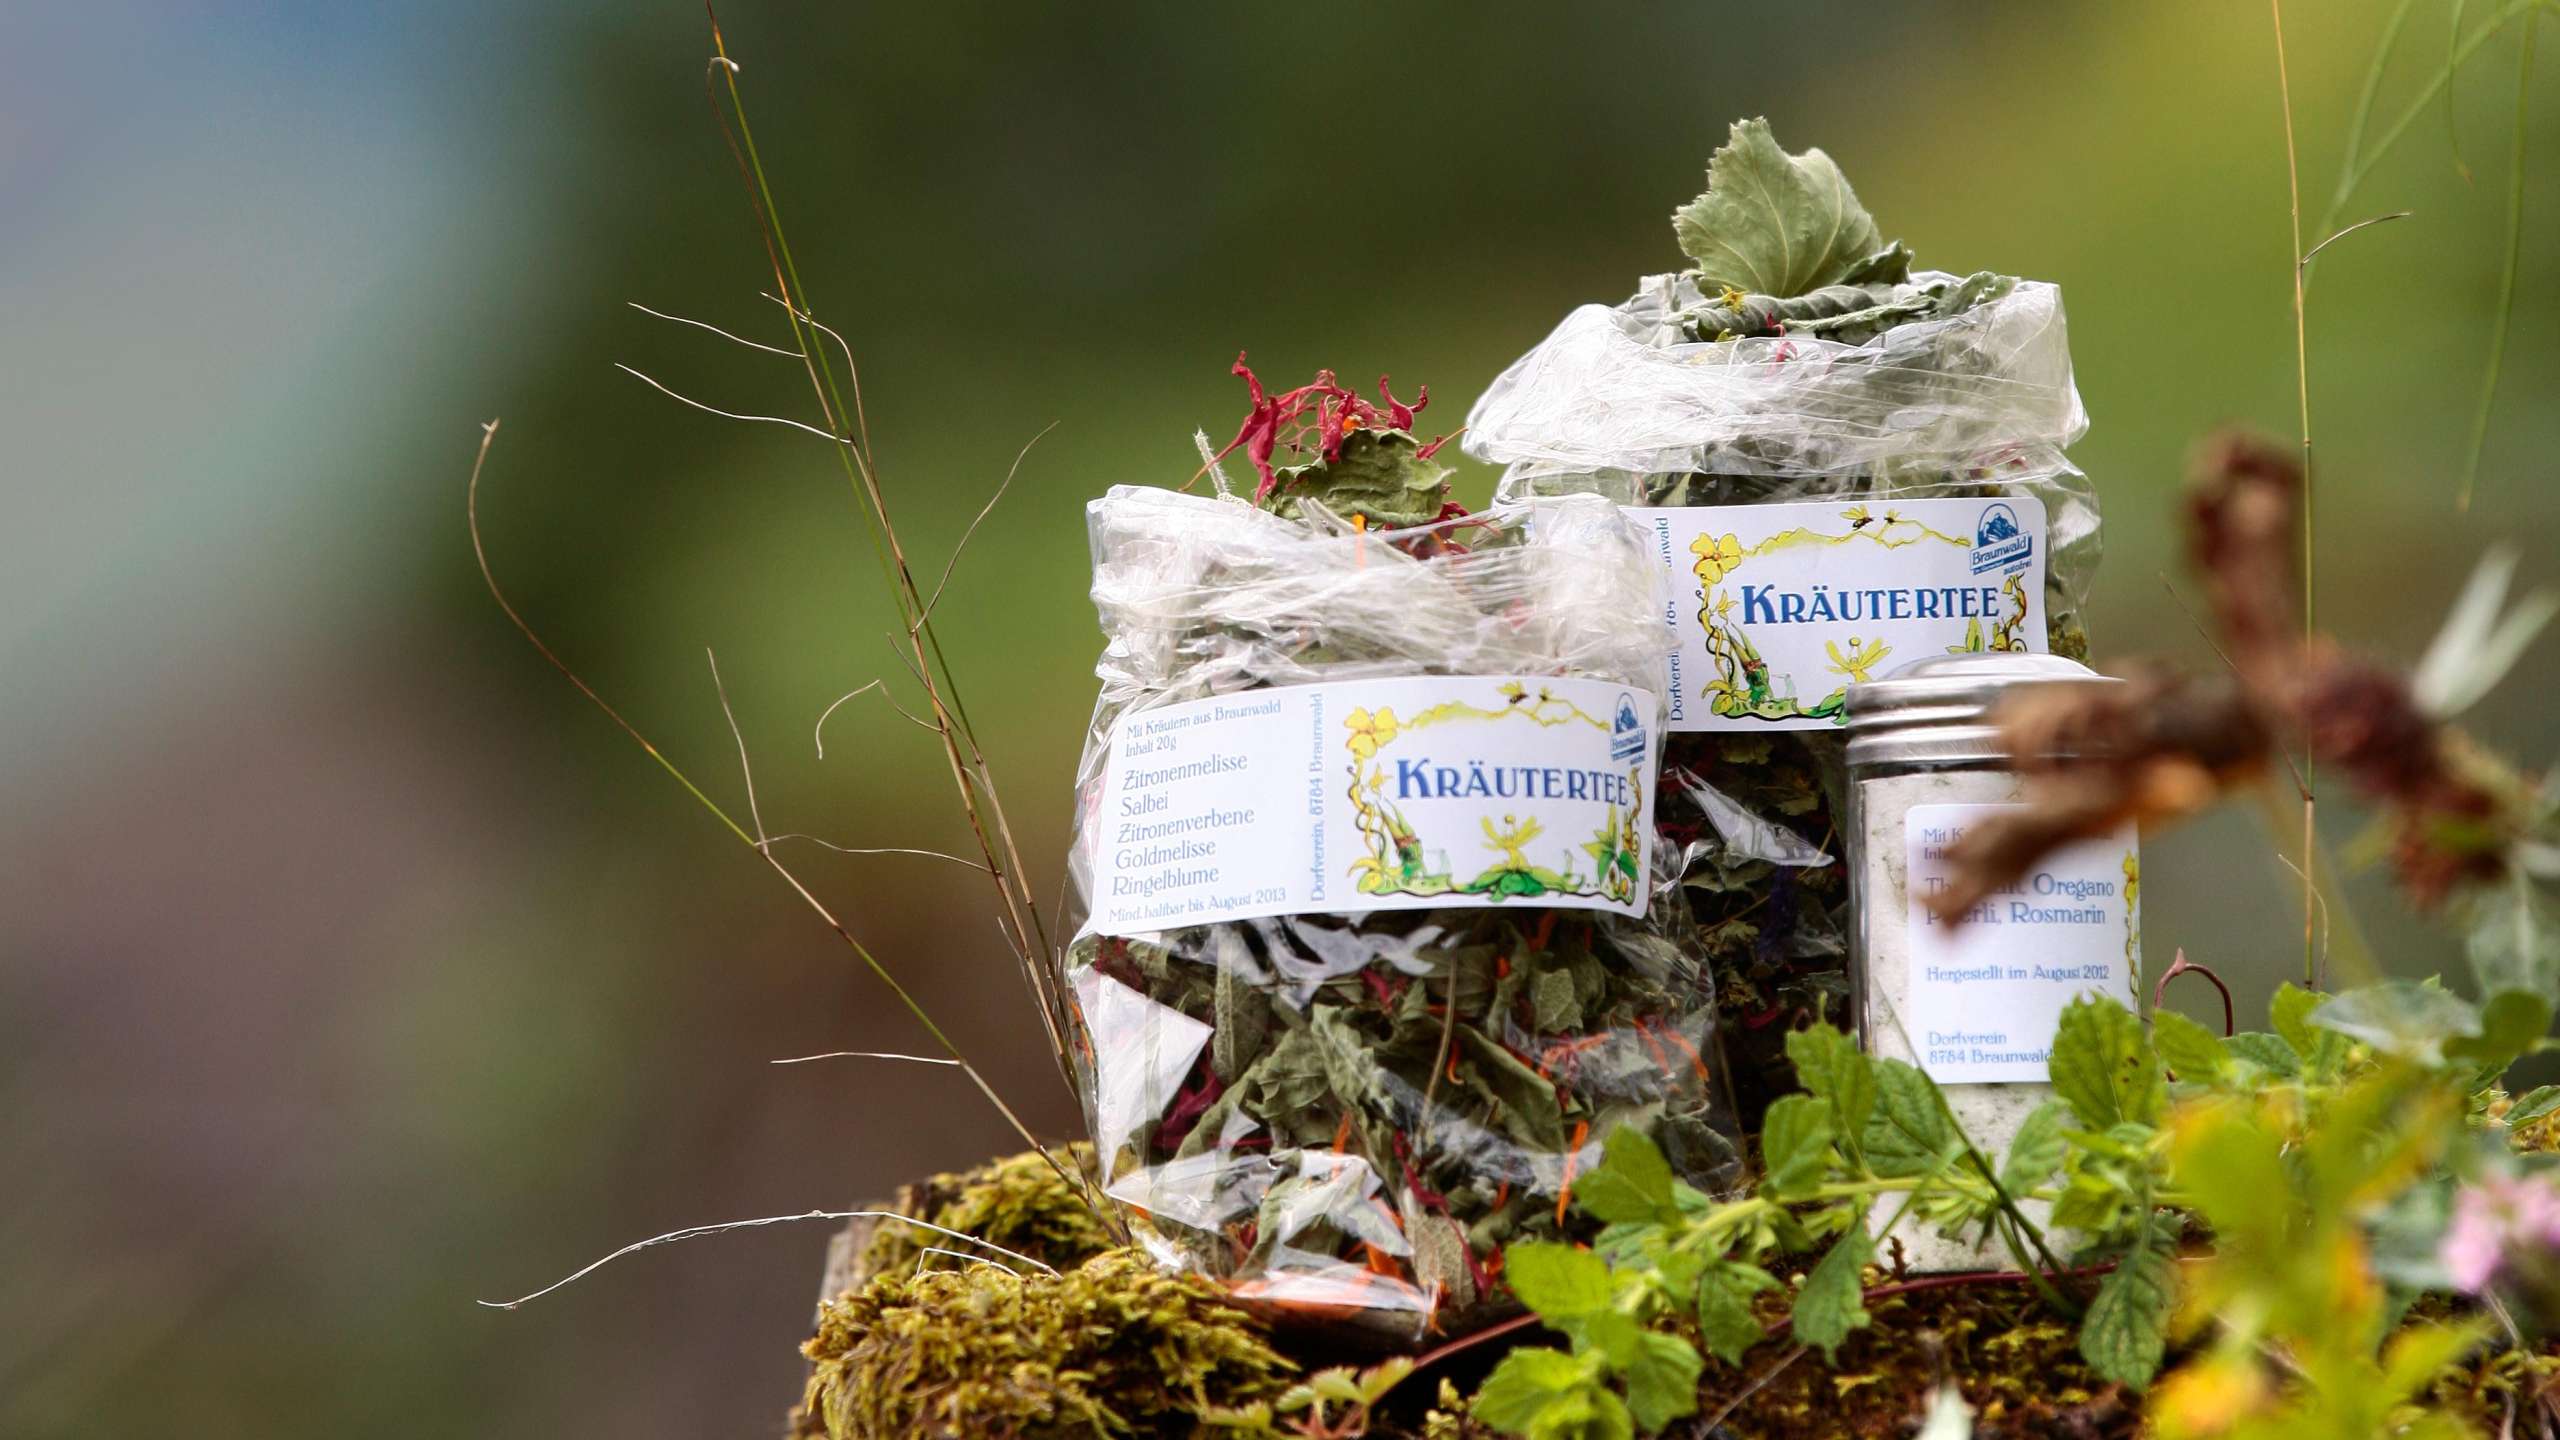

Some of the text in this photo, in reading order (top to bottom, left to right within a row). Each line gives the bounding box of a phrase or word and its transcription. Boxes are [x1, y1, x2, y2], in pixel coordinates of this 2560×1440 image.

[1972, 535, 2028, 565] Braunwald
[1127, 699, 1281, 739] Mit Kräutern aus Braunwald
[1309, 693, 1323, 773] Braunwald
[1125, 734, 1177, 757] Inhalt 20g
[1122, 752, 1248, 791] Zitronenmelisse
[1120, 791, 1170, 817] Salbei
[1309, 777, 1323, 815] 8784
[1117, 808, 1255, 844] Zitronenverbene
[1924, 828, 1946, 843] Mit
[1115, 839, 1217, 870] Goldmelisse
[1112, 867, 1220, 897] Ringelblume
[2033, 872, 2114, 900] Oregano
[1188, 898, 1204, 913] bis
[1209, 893, 1251, 911] August
[1255, 888, 1287, 904] 2013
[2010, 901, 2106, 924] Rosmarin
[1927, 965, 2110, 984] Hergestellt im August 2012
[1928, 1031, 2007, 1046] Dorfverein
[1929, 1050, 1966, 1065] 8784
